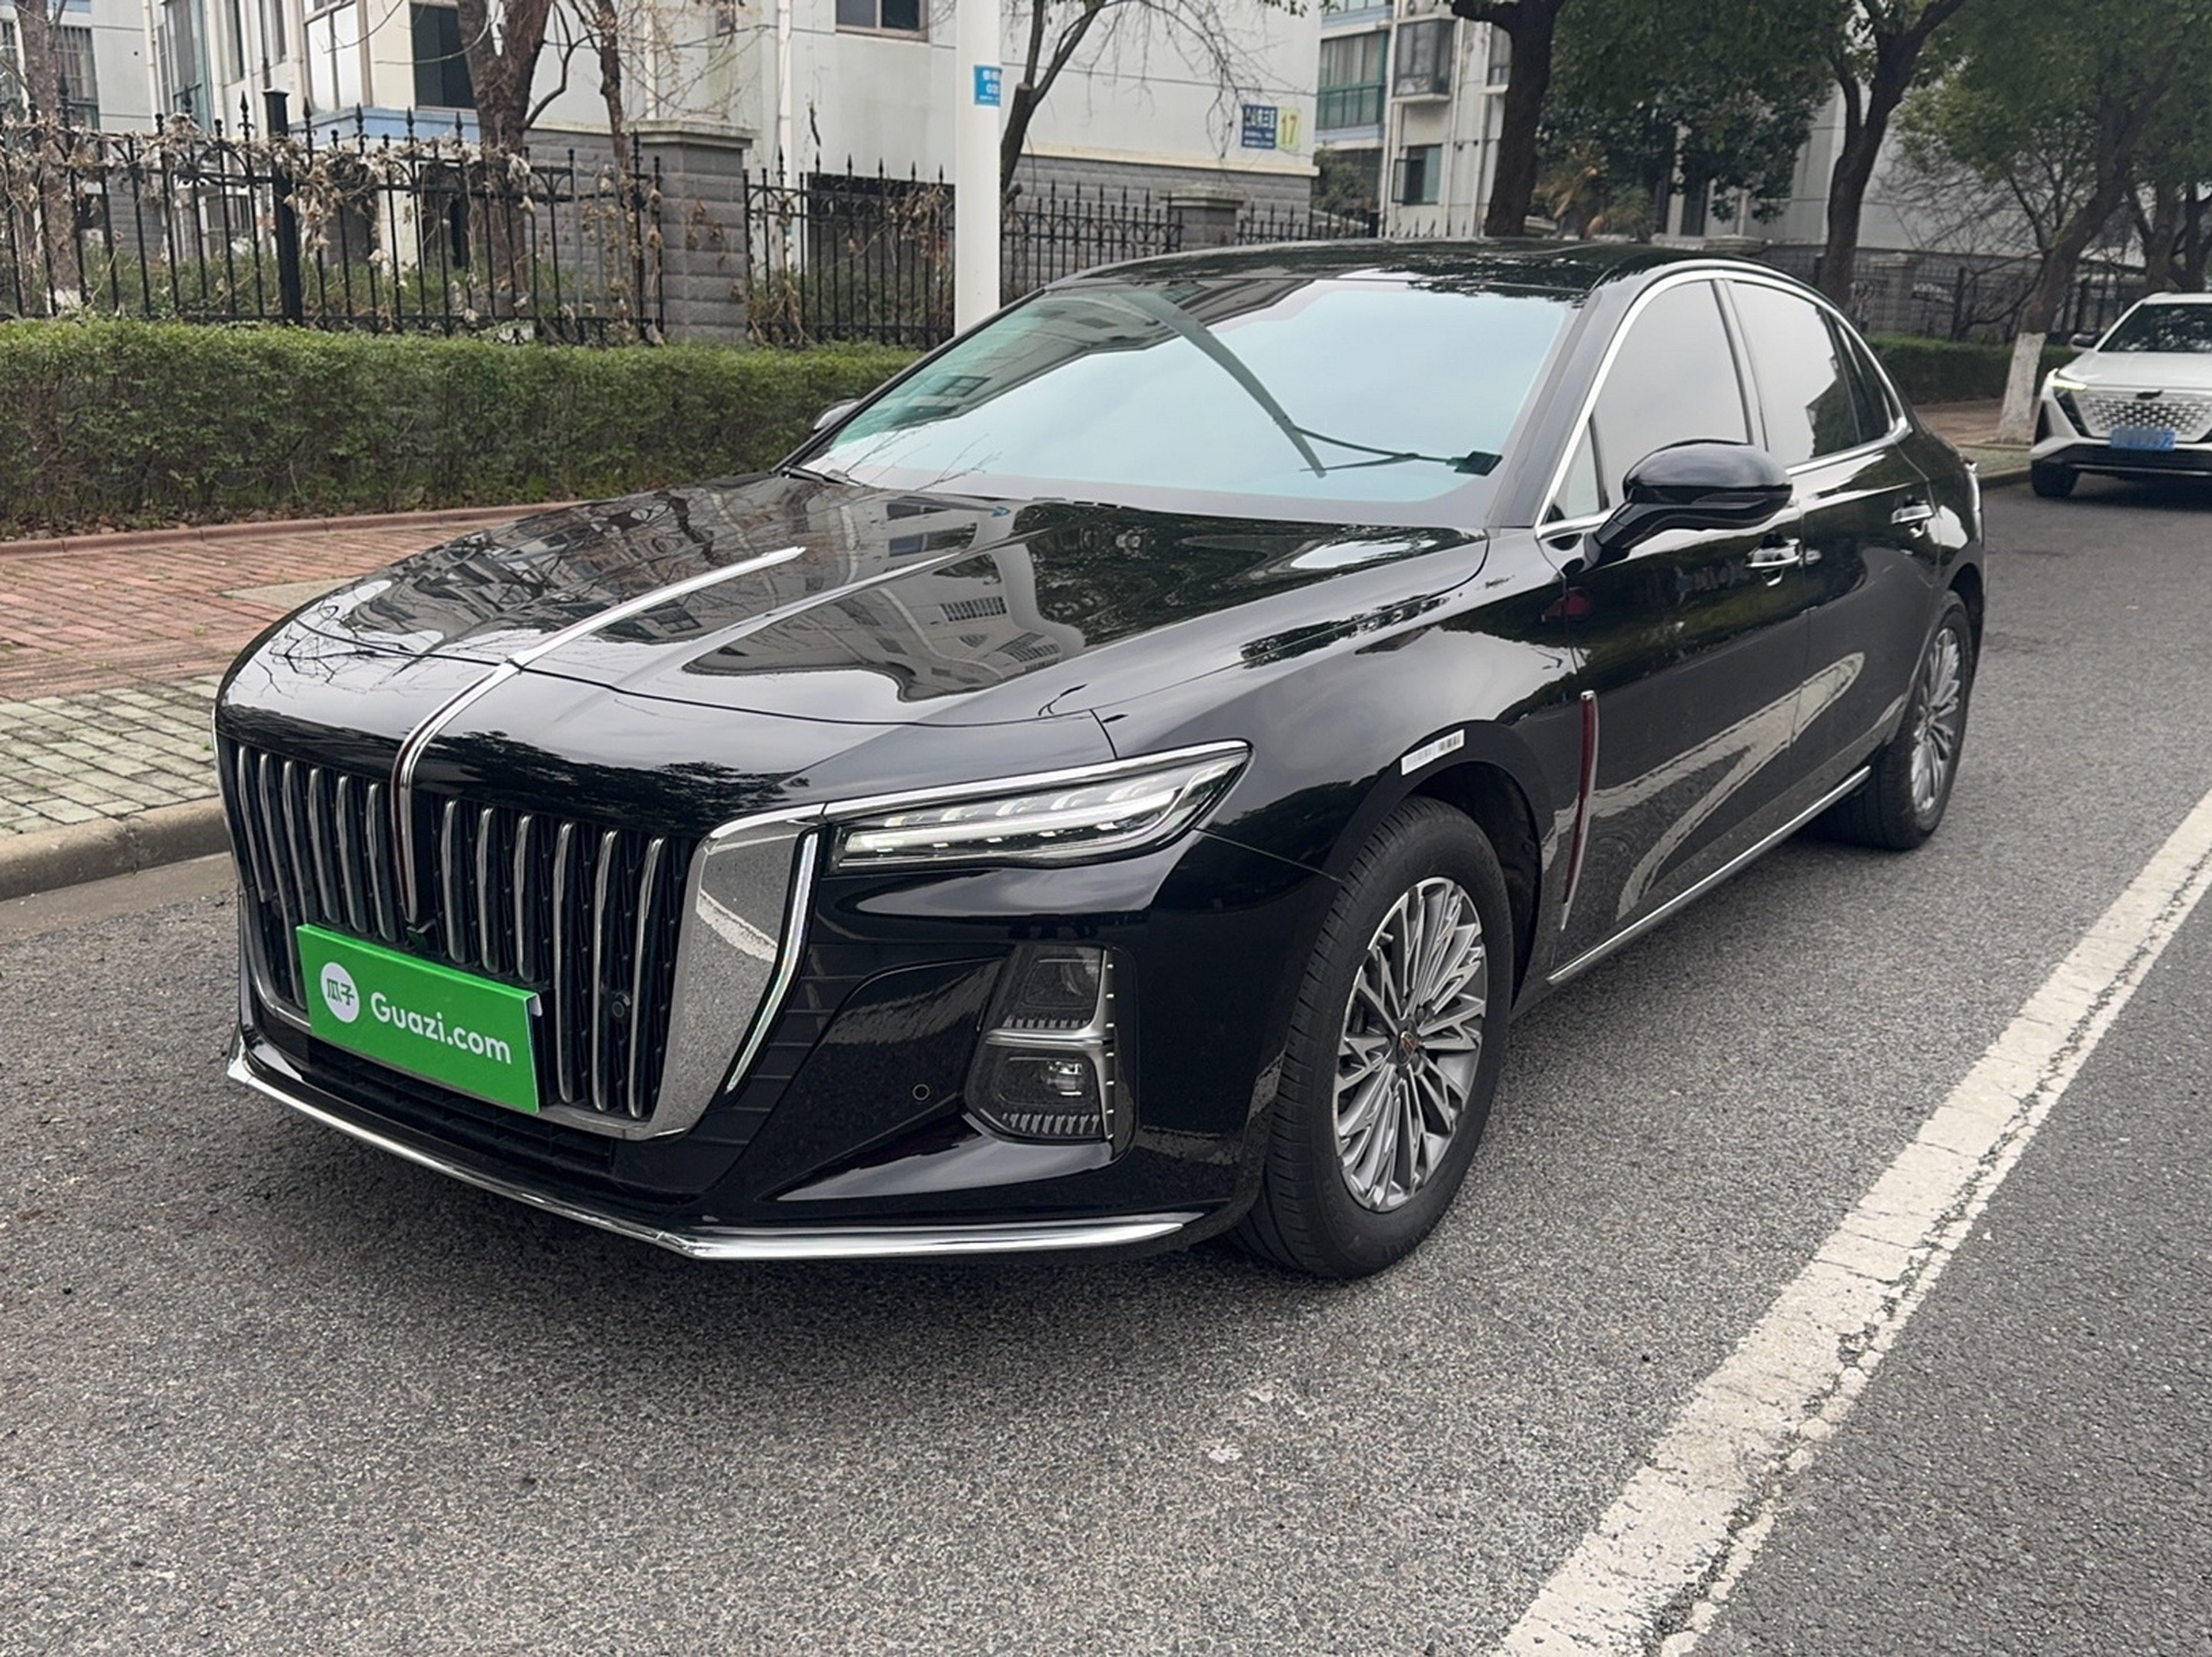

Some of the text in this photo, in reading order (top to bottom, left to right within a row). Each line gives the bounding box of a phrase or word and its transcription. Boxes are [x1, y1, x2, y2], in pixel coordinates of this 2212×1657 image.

[1281, 114, 1298, 145] 17
[327, 978, 354, 1006] 瓜子
[370, 992, 512, 1065] Guazi.com
